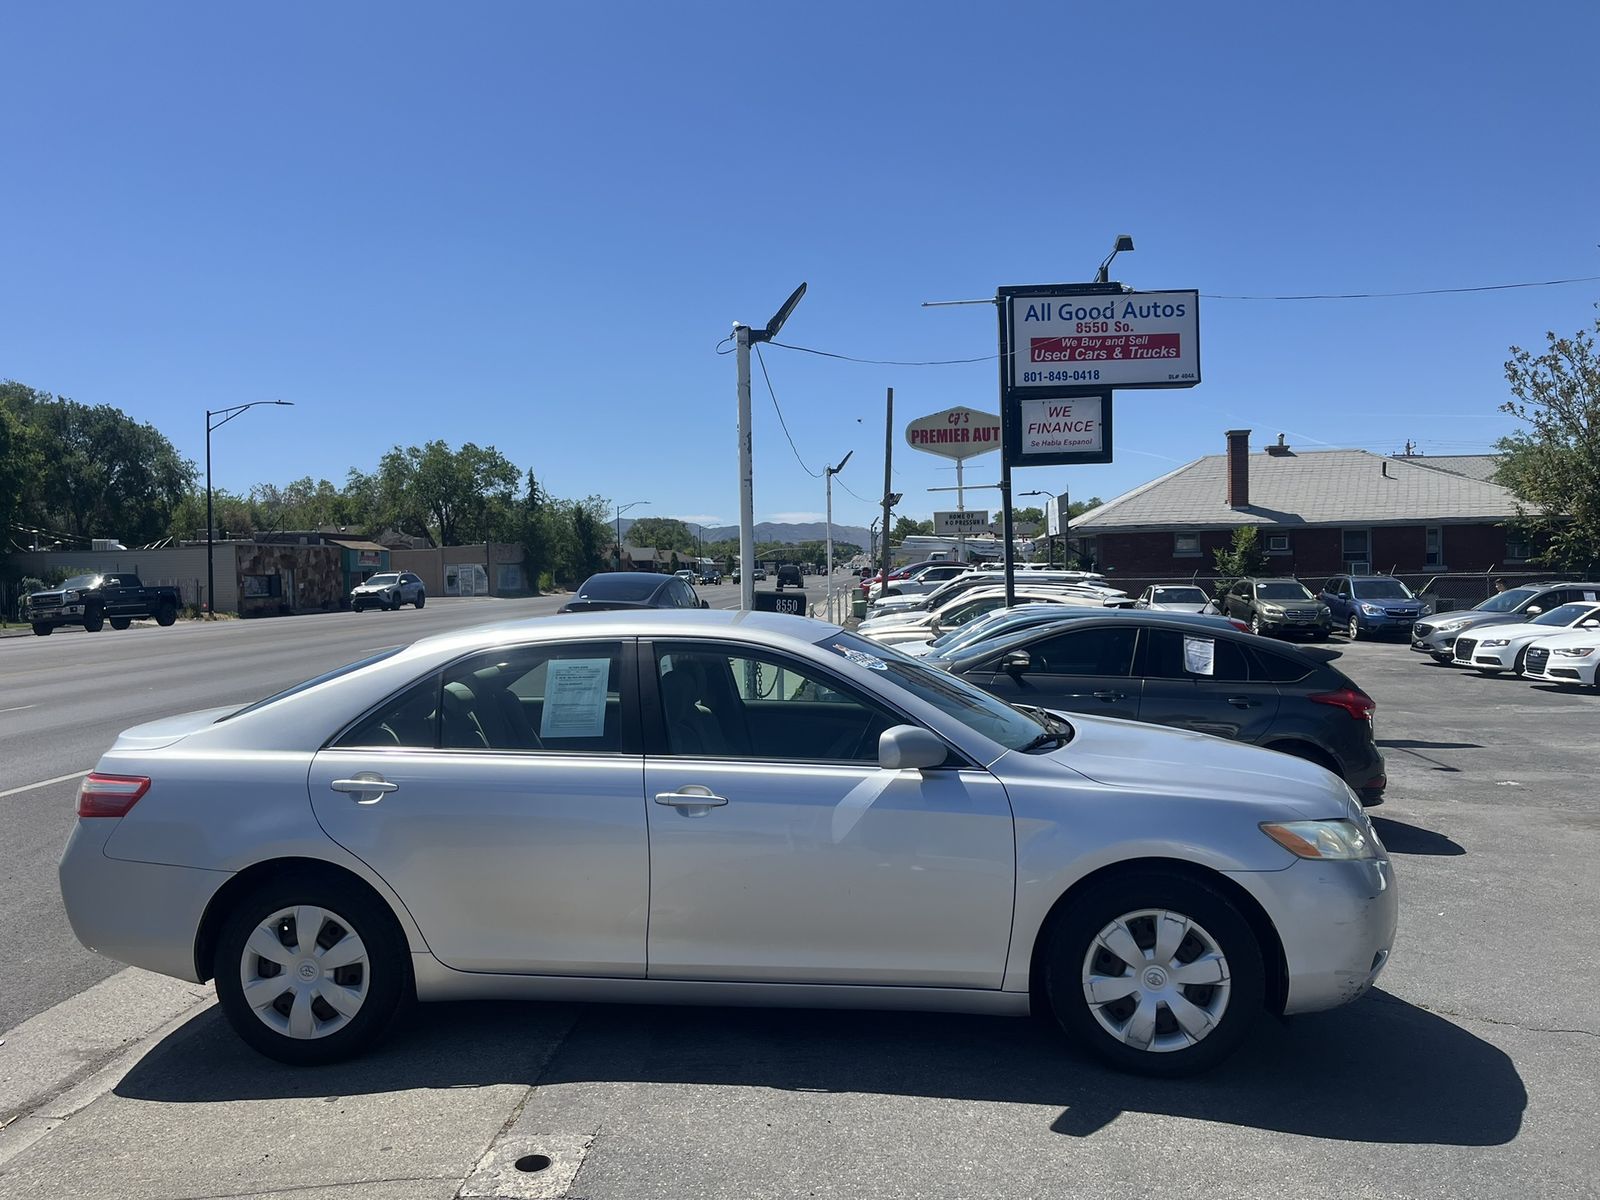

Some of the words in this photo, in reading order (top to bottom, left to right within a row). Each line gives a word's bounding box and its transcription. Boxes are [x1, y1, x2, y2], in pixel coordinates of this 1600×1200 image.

[1024, 303, 1051, 322] All
[1058, 301, 1114, 321] Good
[1122, 301, 1186, 319] Autos
[1075, 322, 1108, 333] 8550
[1114, 321, 1134, 332] So.
[1061, 337, 1078, 347] We
[1081, 337, 1101, 348] Buy
[1105, 336, 1125, 346] and
[1128, 335, 1149, 345] Sell
[1033, 349, 1069, 361] Used
[1075, 348, 1107, 360] Cars
[1112, 348, 1123, 359] &
[1129, 346, 1177, 358] Trucks
[1023, 370, 1100, 382] 801-849-0418
[1048, 406, 1072, 418] WE
[1027, 420, 1094, 435] FINANCE
[911, 428, 970, 444] PREMIER
[972, 426, 1001, 442] AUT
[1041, 439, 1062, 447] Habla
[1063, 438, 1093, 447] Espanol
[776, 598, 798, 612] 8550
